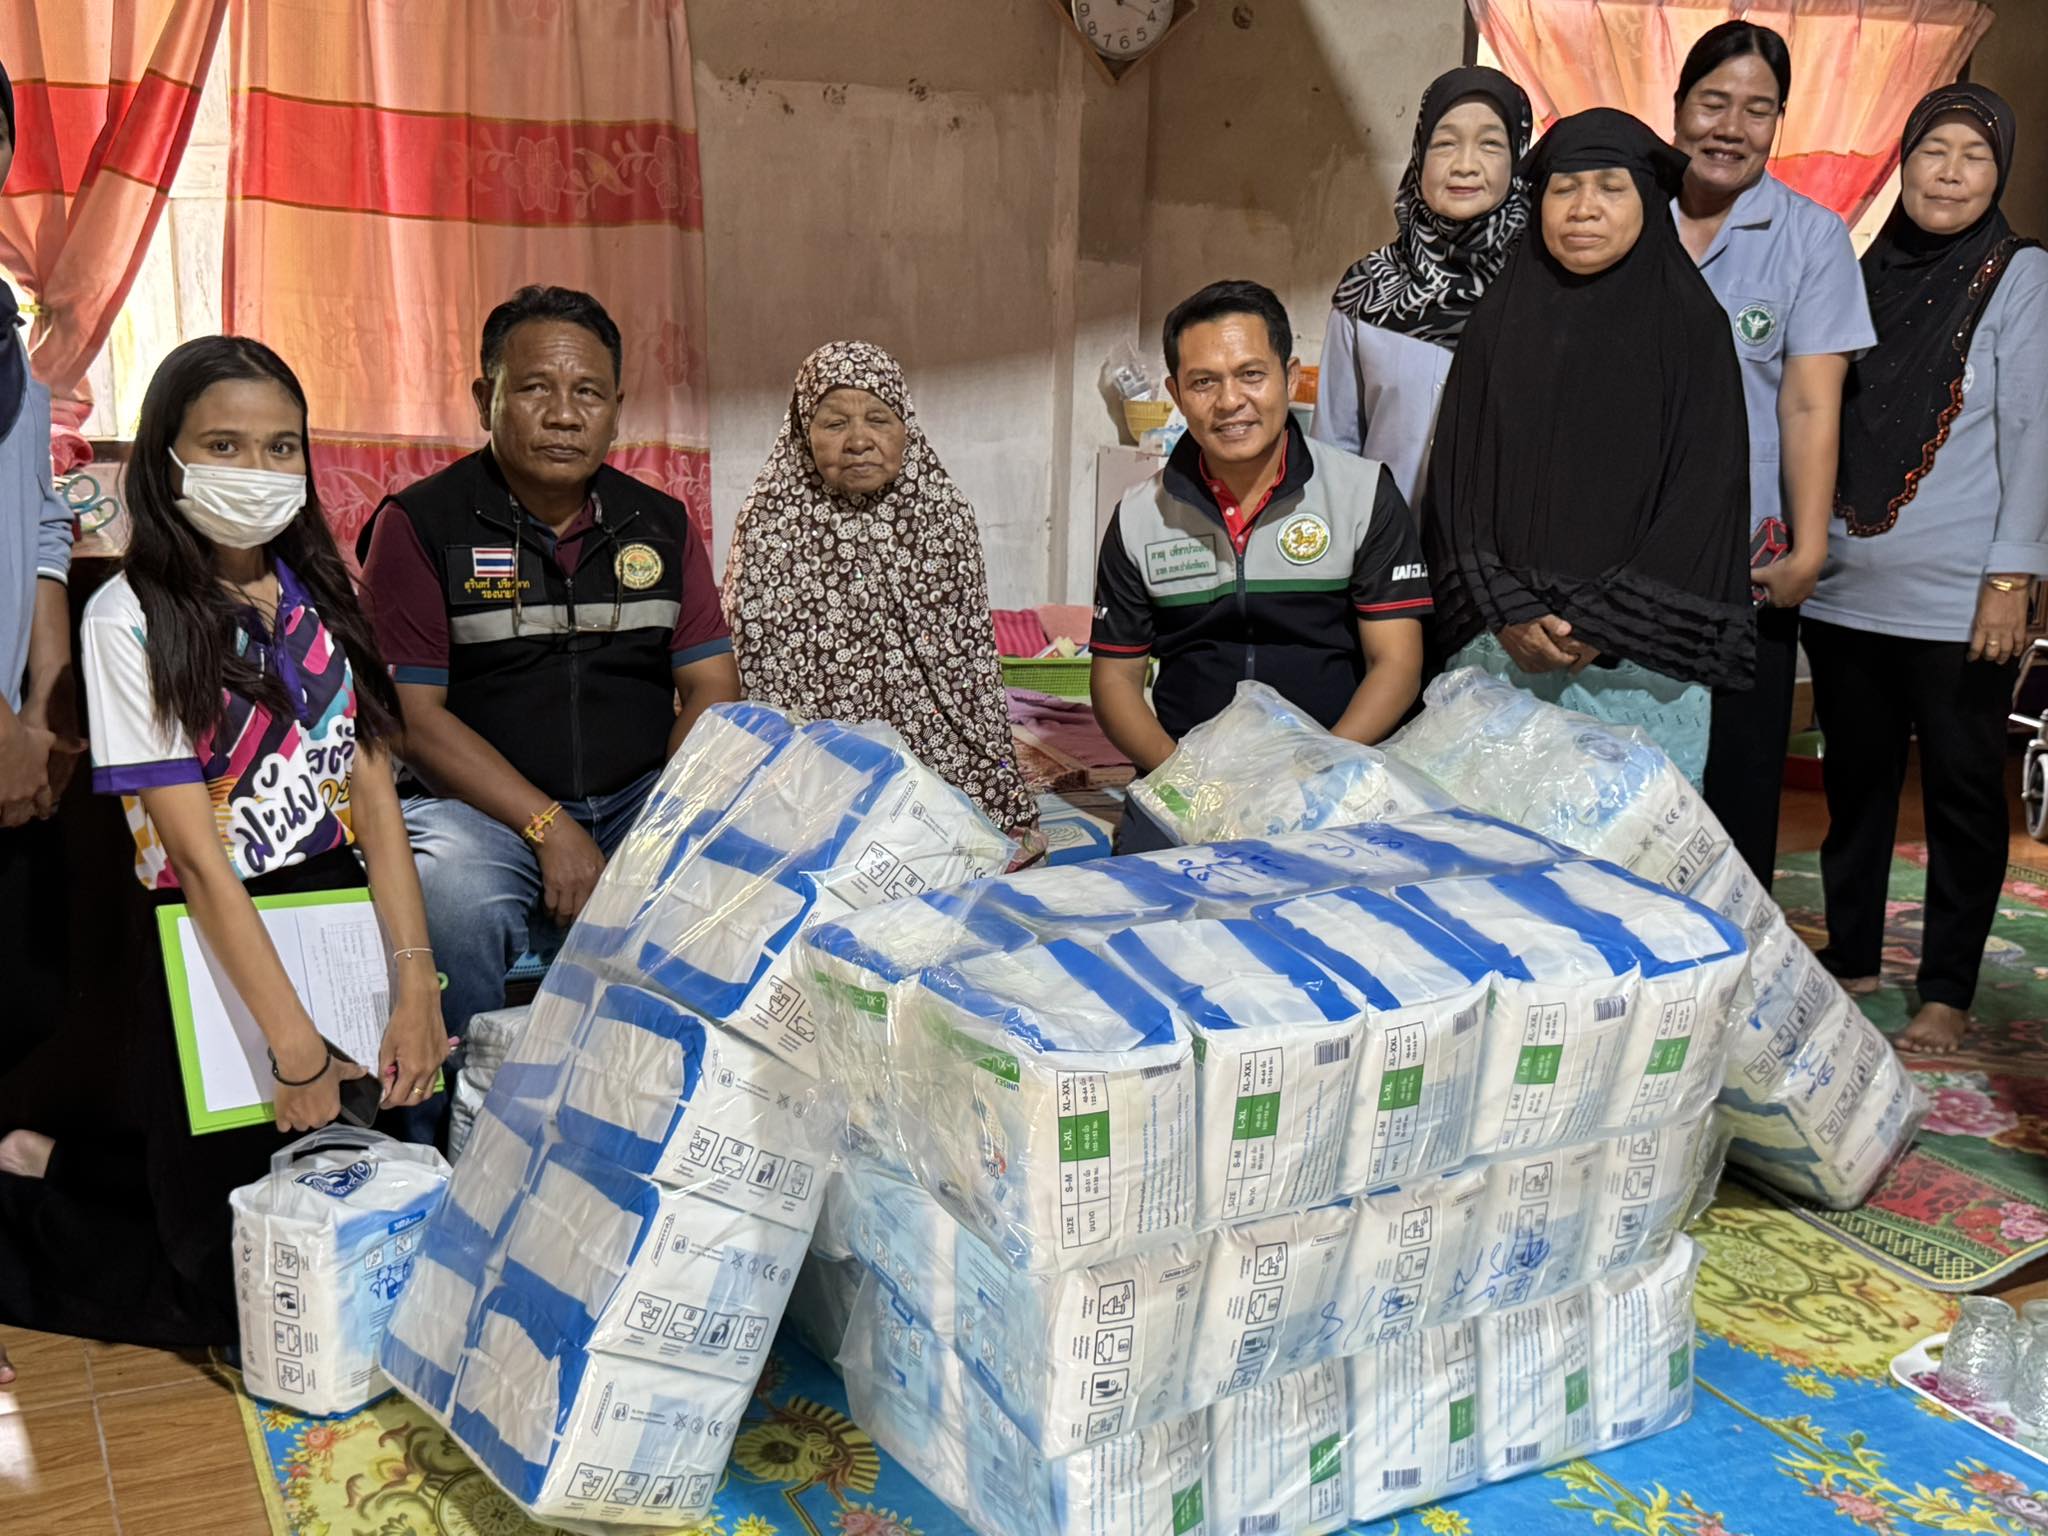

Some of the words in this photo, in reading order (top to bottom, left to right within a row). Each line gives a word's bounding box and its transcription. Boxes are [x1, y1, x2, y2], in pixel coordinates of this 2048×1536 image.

[1079, 3, 1090, 17] 9
[1147, 8, 1156, 22] 4
[1087, 20, 1097, 36] 8
[1136, 27, 1147, 41] 5
[1103, 33, 1112, 48] 7
[1120, 35, 1130, 49] 6
[1528, 1012, 1538, 1041] XL-XXL
[1389, 1036, 1397, 1066] XL-XXL
[1243, 1060, 1251, 1092] XL-XXL
[1062, 1078, 1071, 1111] XL-XXL
[1384, 1082, 1393, 1100] L-XL
[1239, 1109, 1247, 1128] L-XL
[1378, 1122, 1386, 1136] S-M
[1064, 1129, 1072, 1150] L-XL
[1233, 1151, 1241, 1167] S-M
[1065, 1174, 1073, 1192] S-M
[1228, 1191, 1236, 1207] SIZE
[1066, 1217, 1074, 1234] SIZE
[1088, 1211, 1096, 1232] ขนาด
[762, 1263, 779, 1281] CE
[707, 1419, 723, 1437] CE
